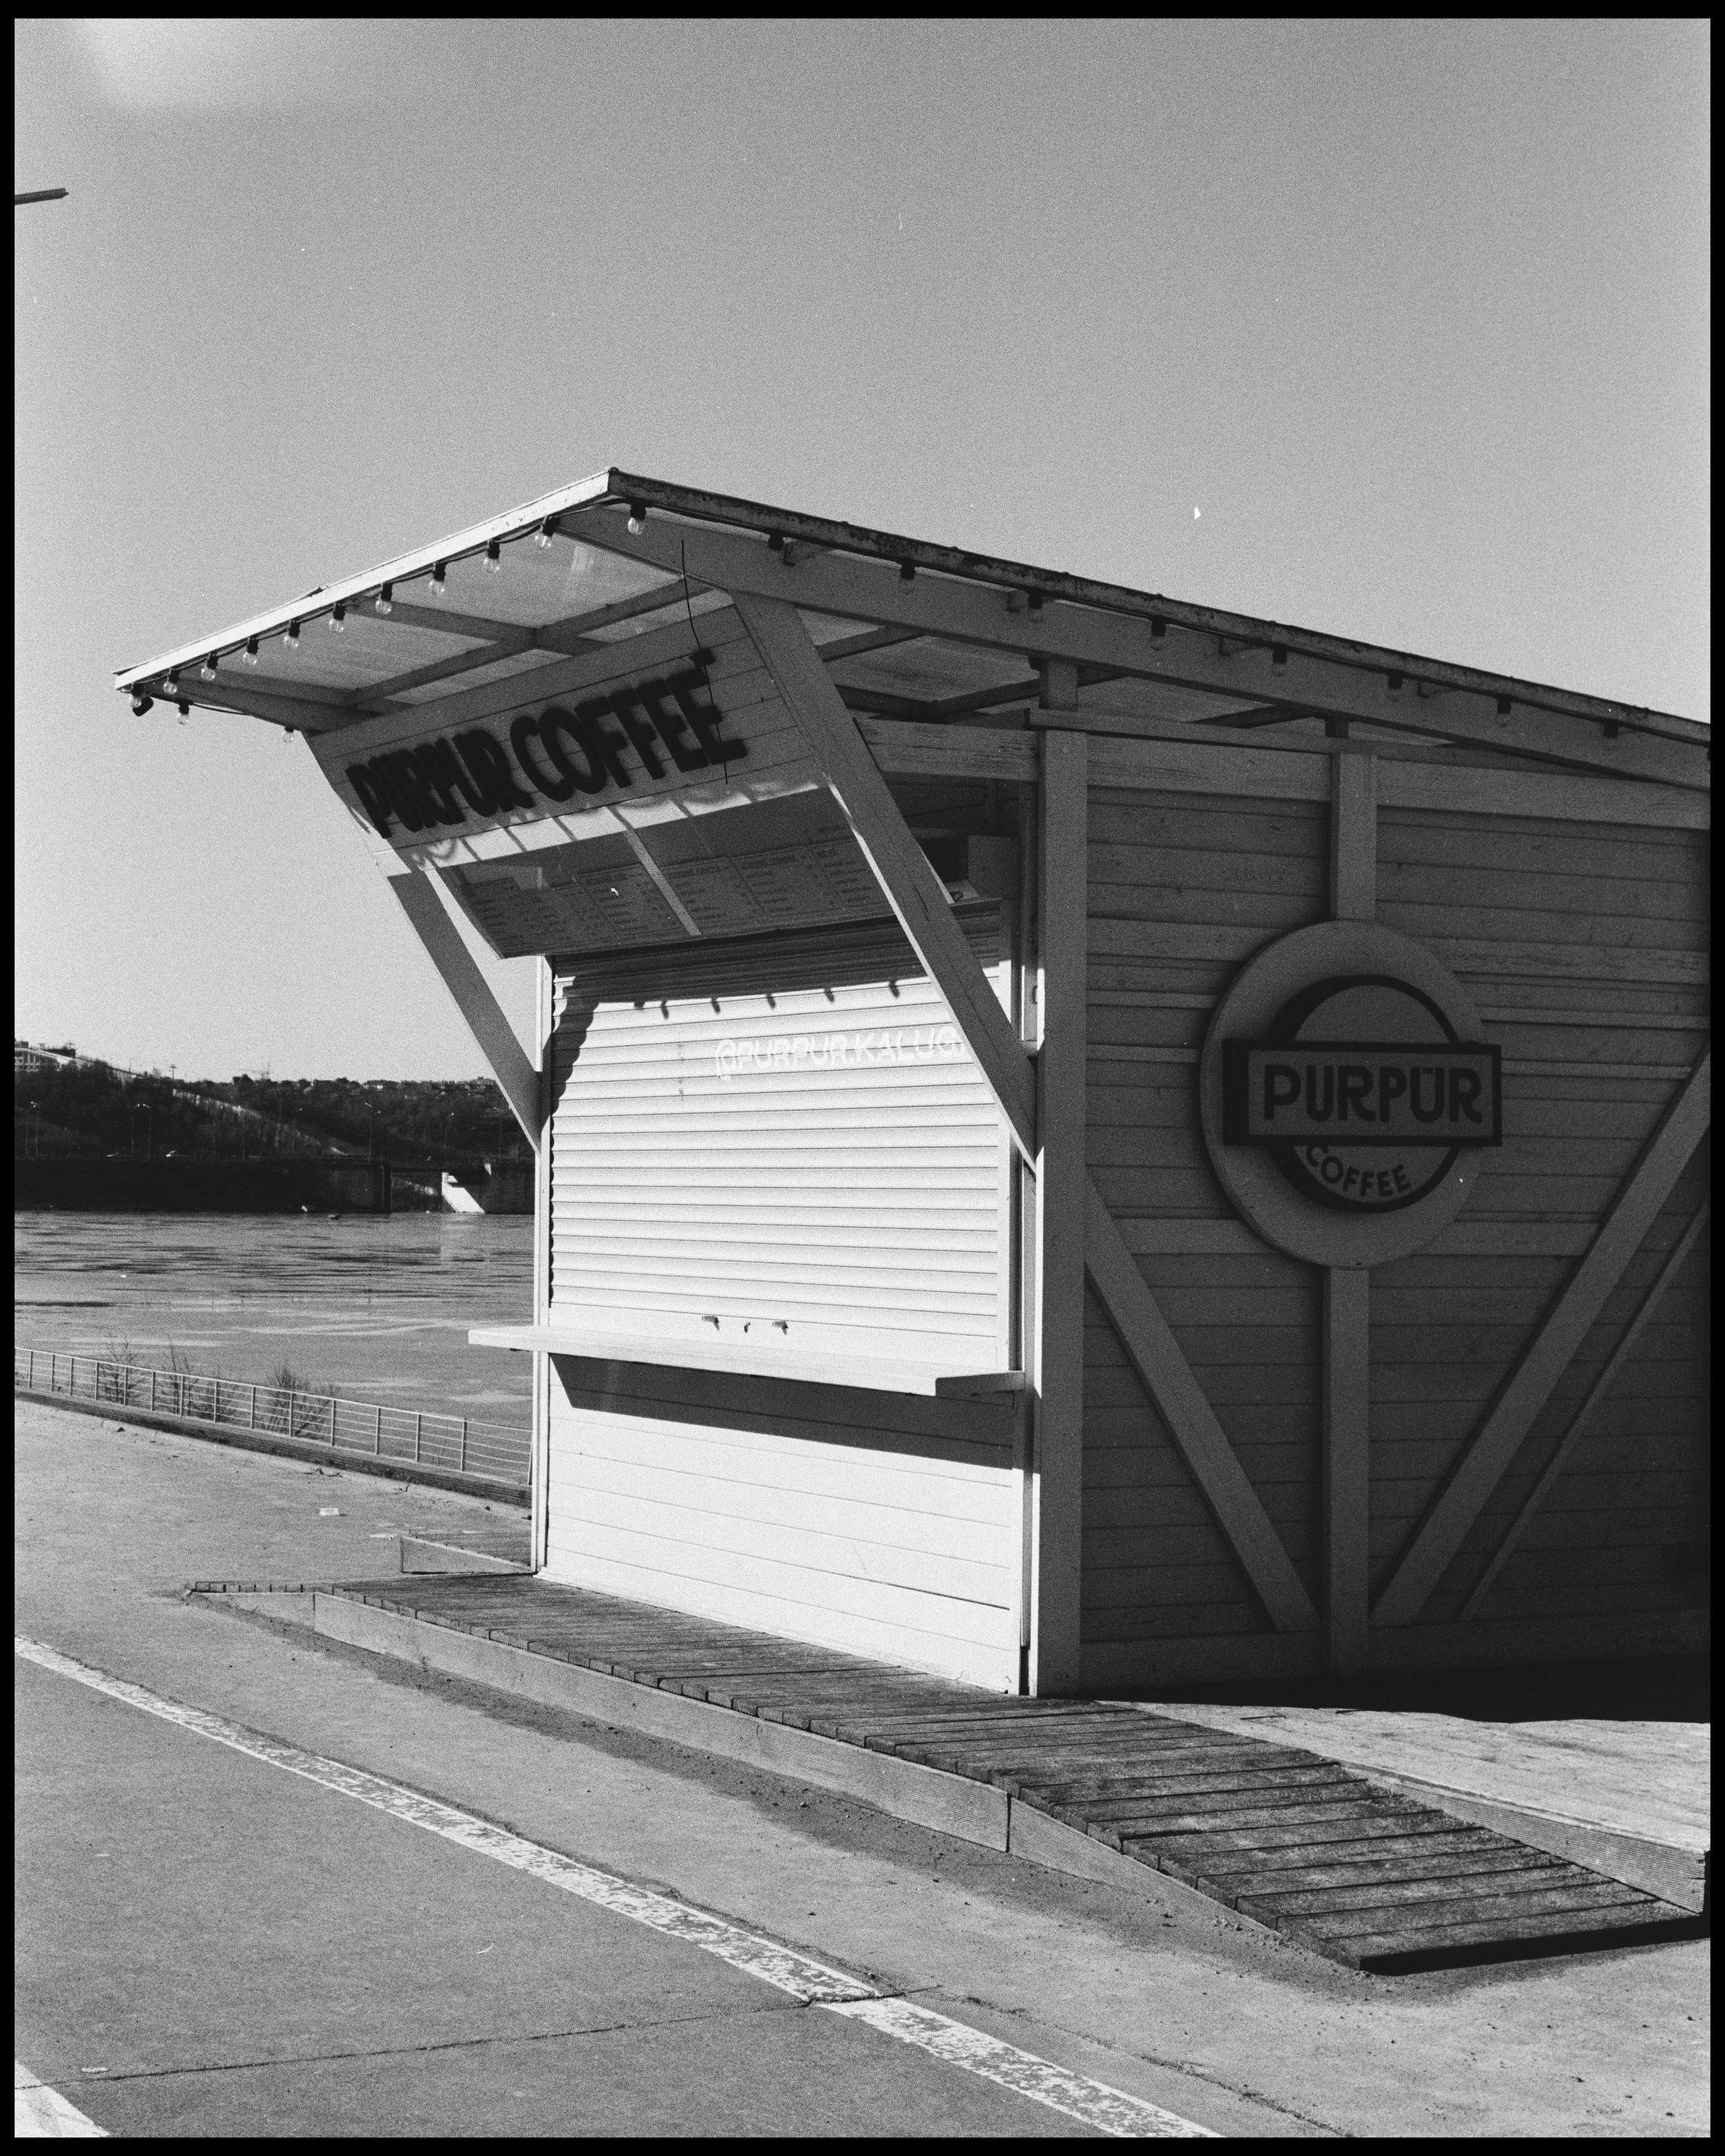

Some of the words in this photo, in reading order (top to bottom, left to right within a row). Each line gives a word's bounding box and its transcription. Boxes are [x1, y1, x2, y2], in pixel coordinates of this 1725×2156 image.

[345, 728, 536, 838] PURPUR
[510, 667, 748, 802] COFFEE
[716, 1025, 966, 1081] @PURPUR.KALUG
[1305, 1145, 1412, 1197] COFFEE
